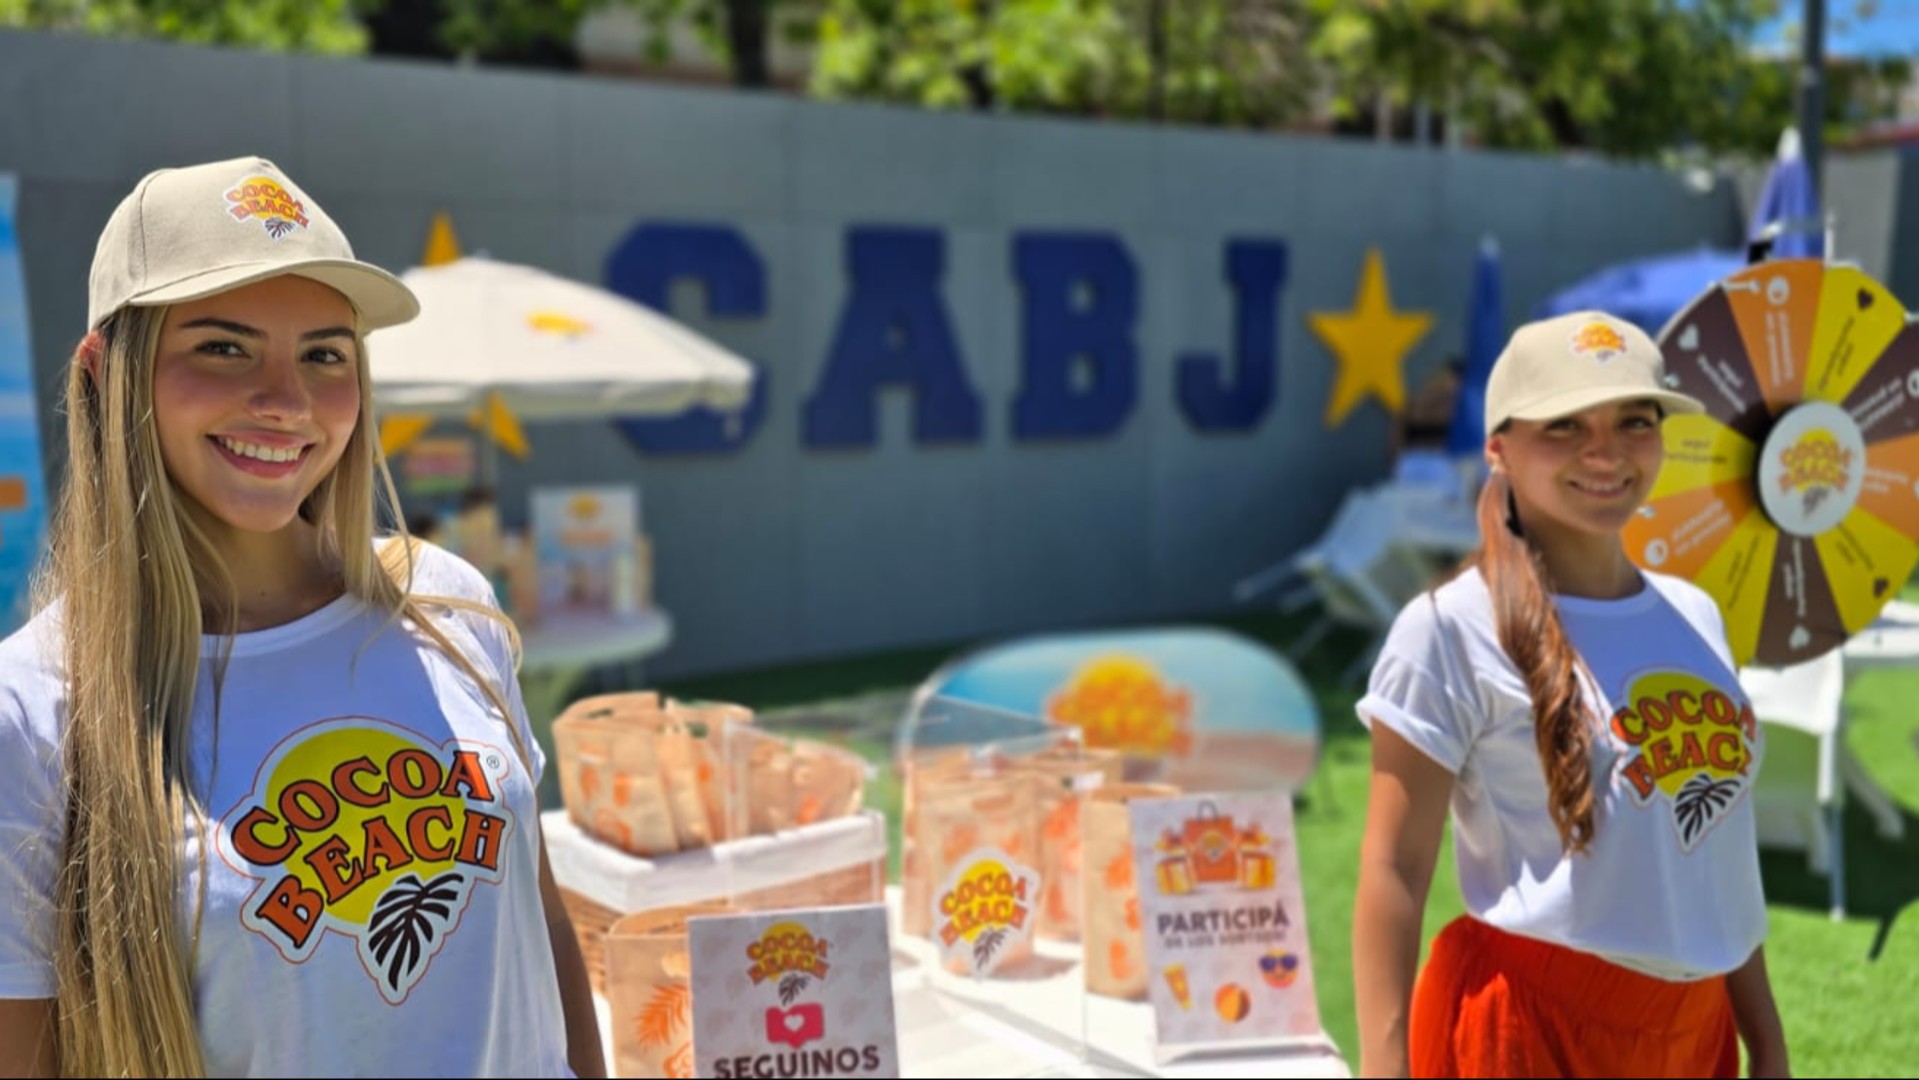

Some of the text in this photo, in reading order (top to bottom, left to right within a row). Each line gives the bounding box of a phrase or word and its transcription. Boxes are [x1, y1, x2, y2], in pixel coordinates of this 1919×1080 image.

[226, 184, 305, 214] COCOA
[230, 199, 309, 229] BEACH
[606, 220, 1288, 456] CABJ
[1610, 689, 1756, 746] COCOA
[231, 749, 494, 866] COCOA
[255, 805, 506, 949] BEACH
[713, 1044, 880, 1079] SEGUINOS
